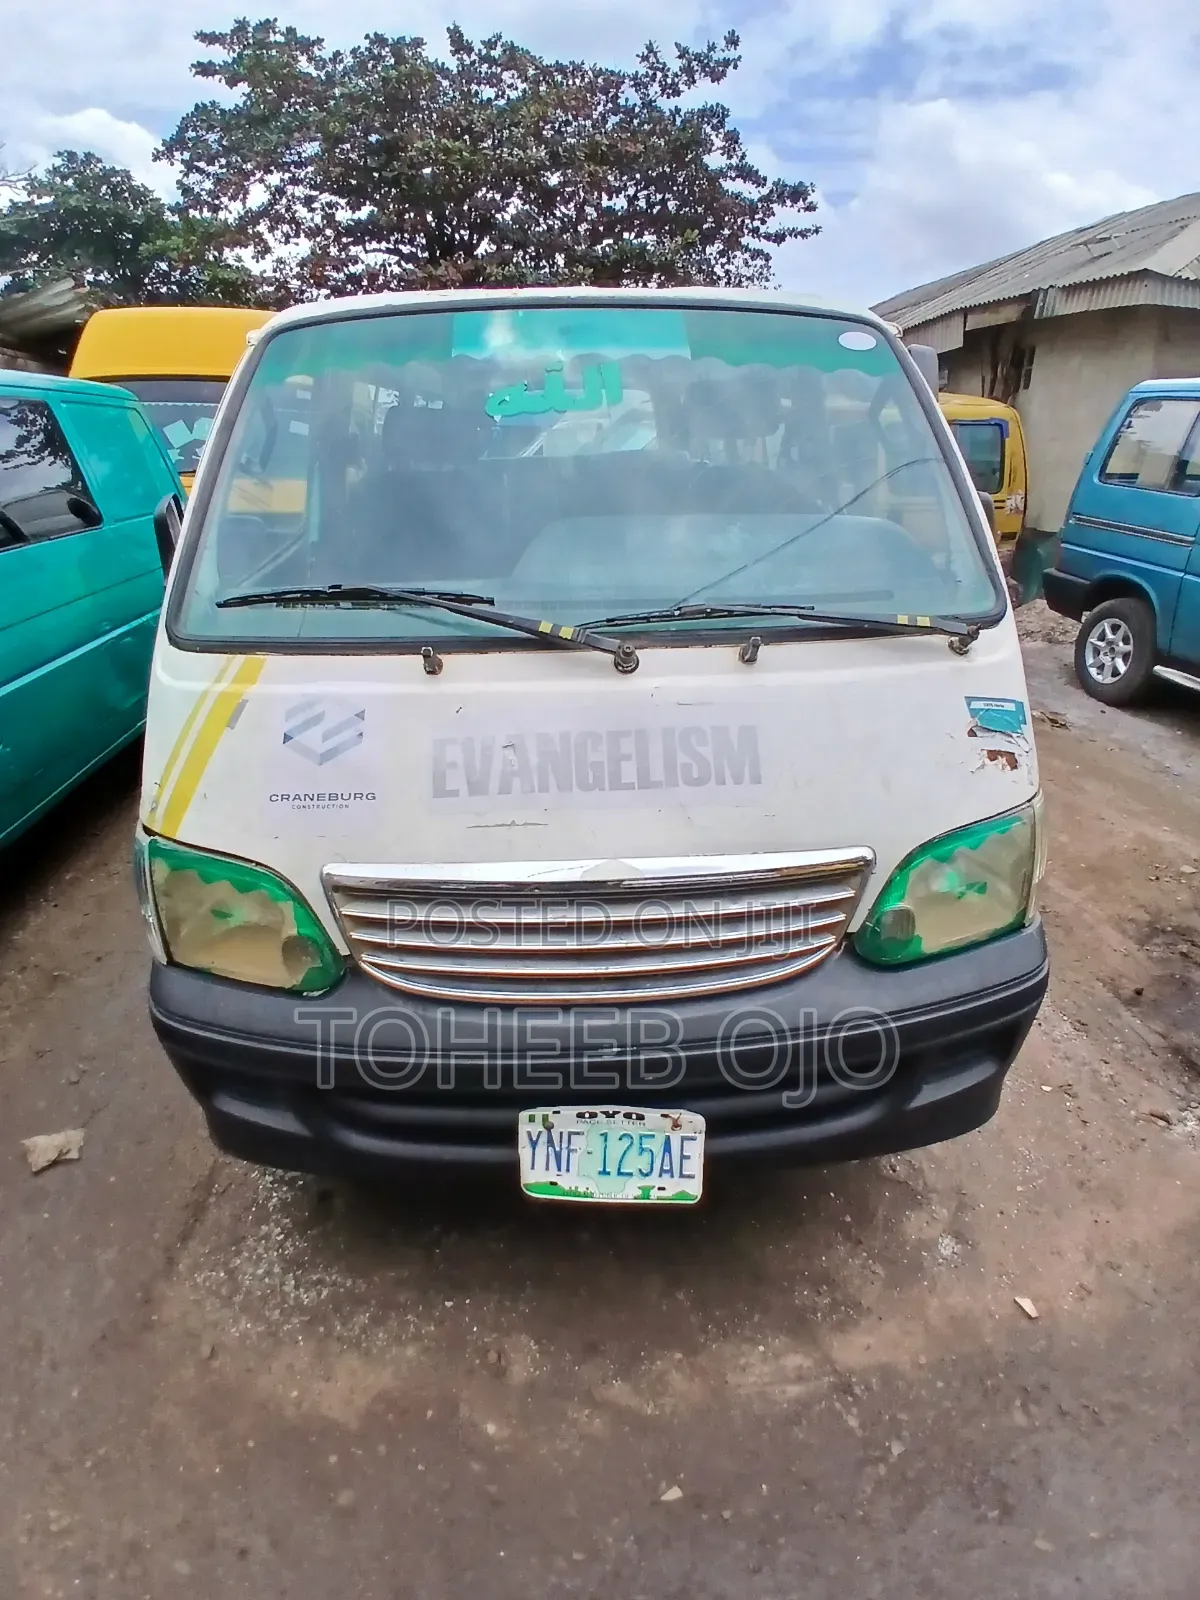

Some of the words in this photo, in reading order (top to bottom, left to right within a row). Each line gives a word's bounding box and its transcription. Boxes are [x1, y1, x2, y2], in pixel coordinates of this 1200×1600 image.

[432, 725, 762, 798] EVANGELISM
[269, 792, 376, 802] CRANEBURG
[576, 1110, 645, 1121] OYO
